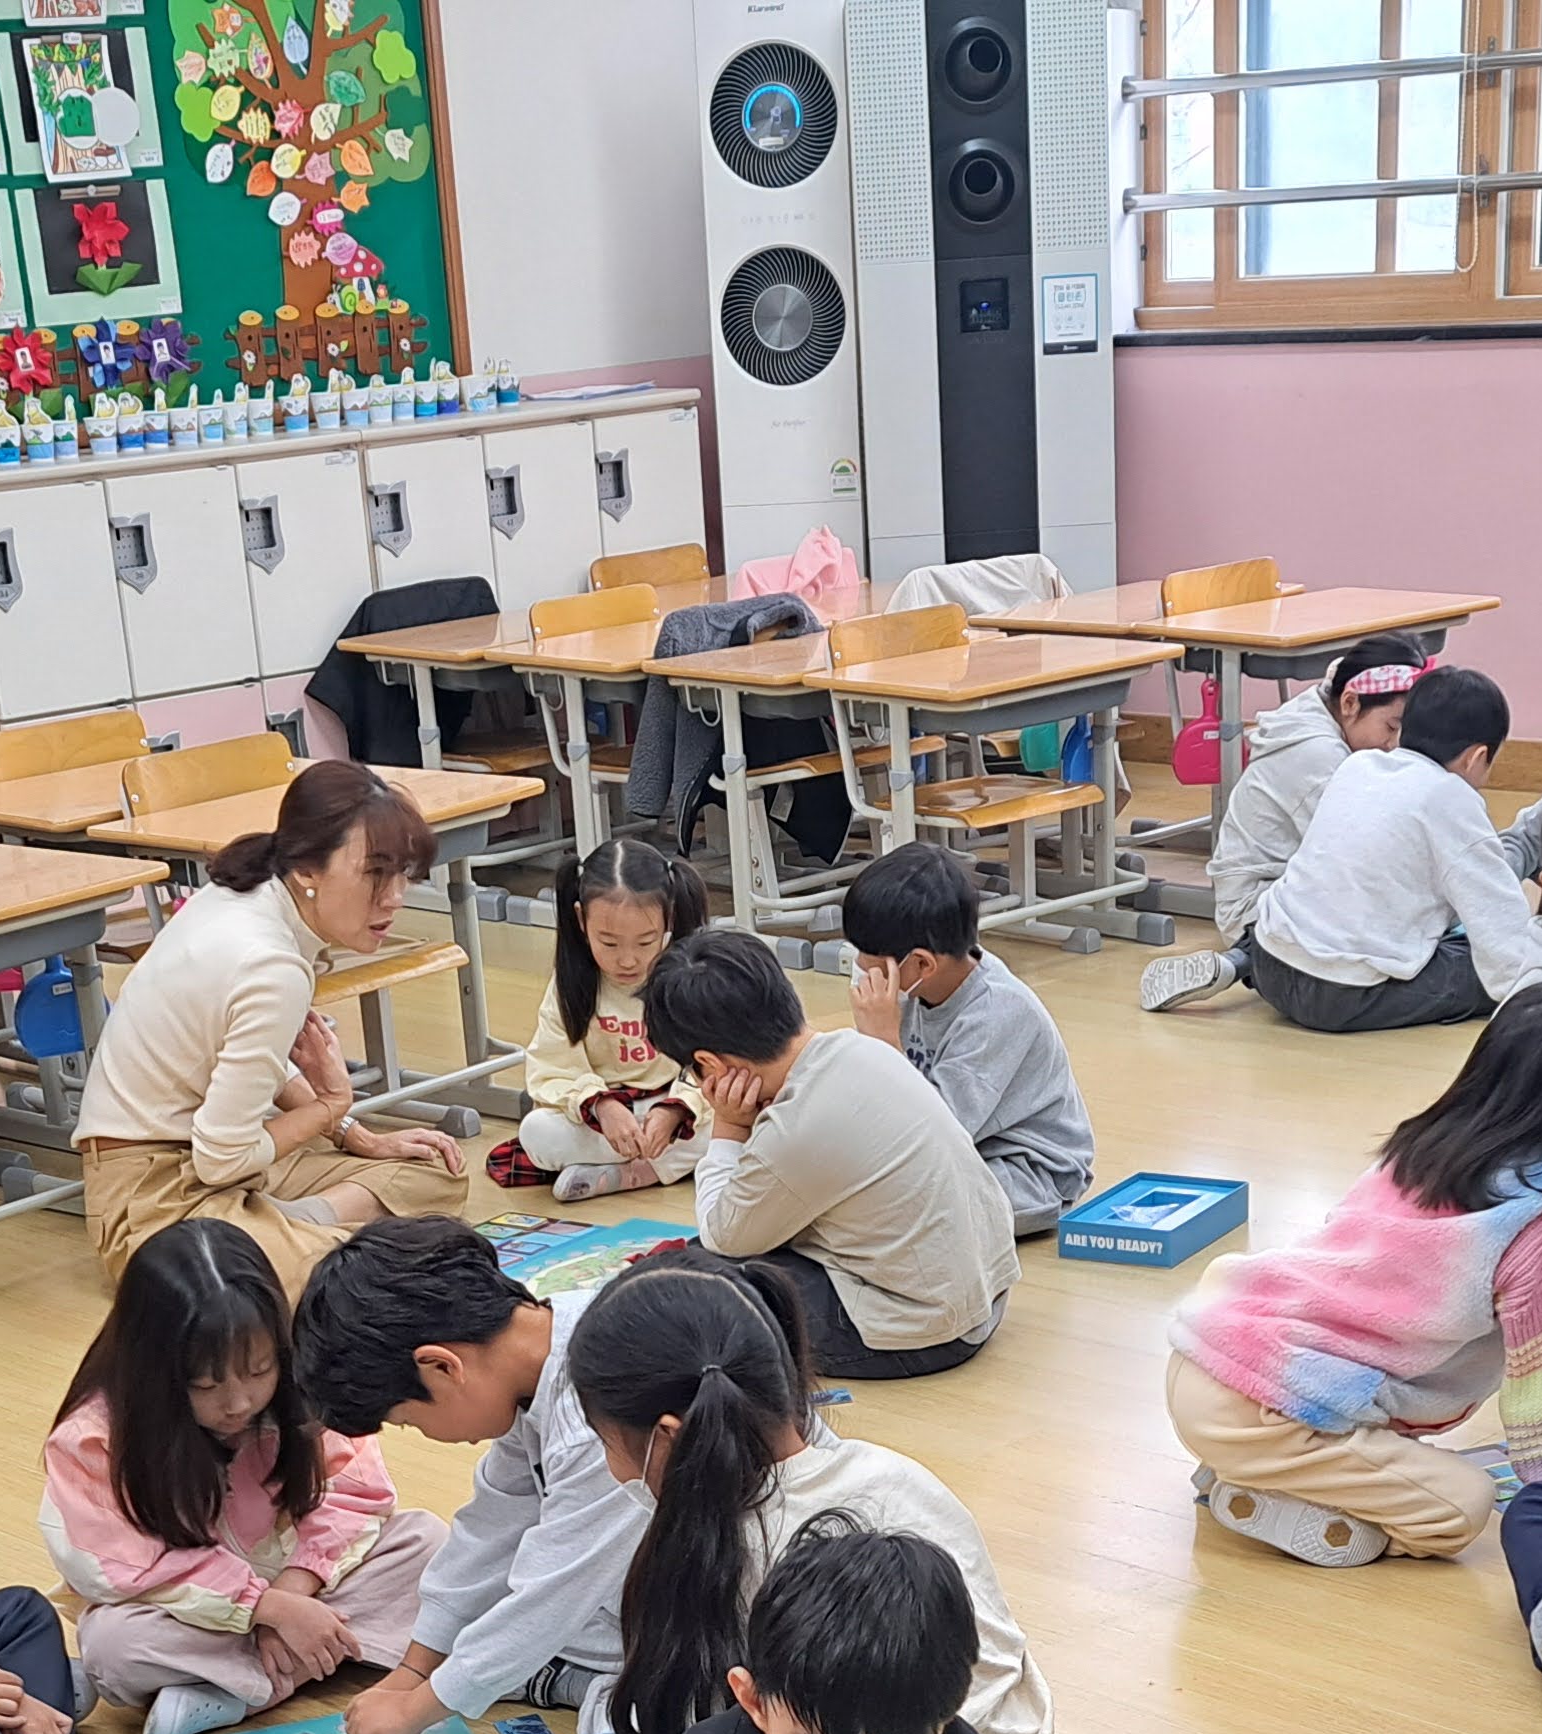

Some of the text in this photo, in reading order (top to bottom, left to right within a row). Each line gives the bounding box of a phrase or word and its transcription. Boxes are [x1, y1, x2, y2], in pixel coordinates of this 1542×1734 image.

[1064, 1233, 1163, 1255] ARE YOU READY?
